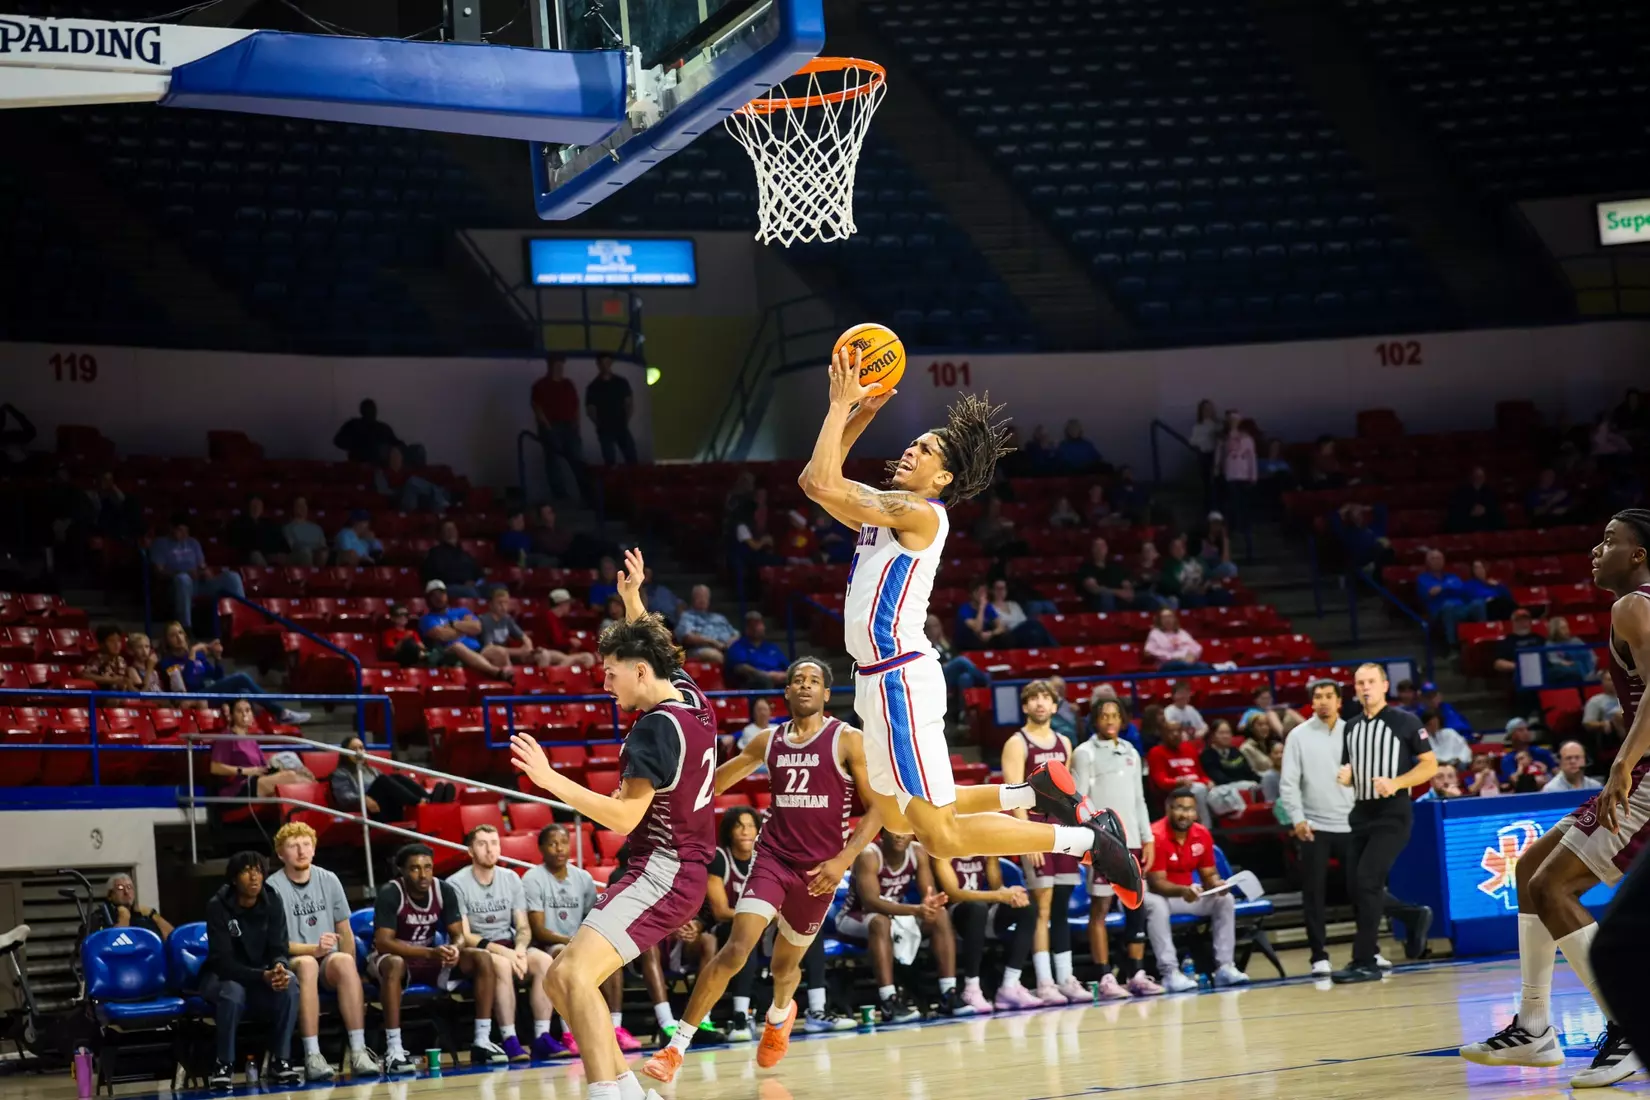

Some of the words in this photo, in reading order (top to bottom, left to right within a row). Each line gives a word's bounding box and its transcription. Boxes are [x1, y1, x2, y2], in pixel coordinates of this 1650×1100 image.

[859, 349, 897, 379] Wilso
[1375, 340, 1422, 367] 102
[49, 352, 97, 383] 119
[928, 361, 971, 388] 101
[776, 753, 820, 767] DALLAS
[784, 768, 810, 793] 22
